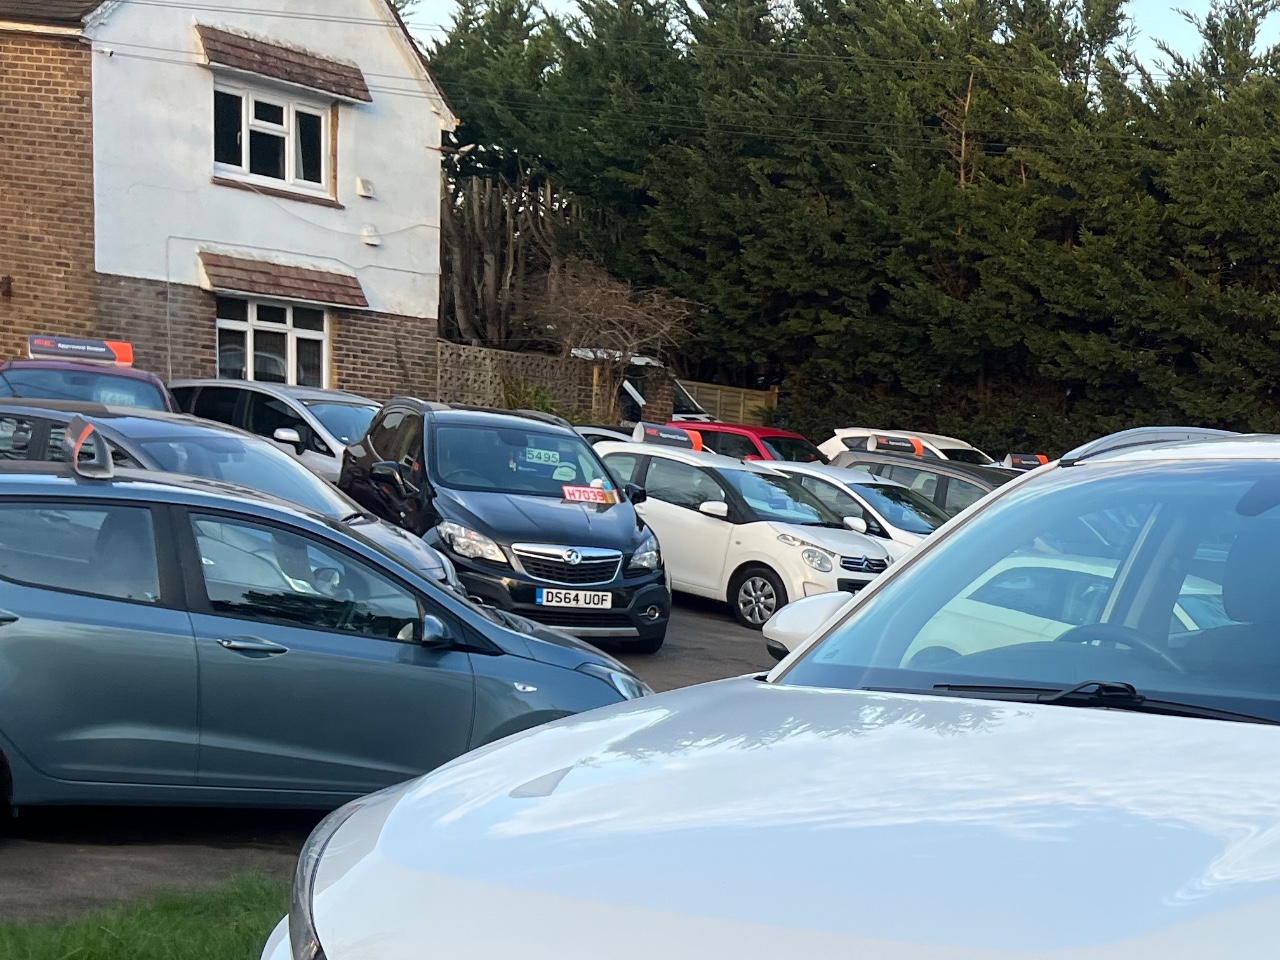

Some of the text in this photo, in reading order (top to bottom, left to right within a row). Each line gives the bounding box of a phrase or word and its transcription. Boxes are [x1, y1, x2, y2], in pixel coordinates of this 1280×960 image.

[527, 449, 559, 464] 5495
[546, 590, 609, 606] DS64 UOF
